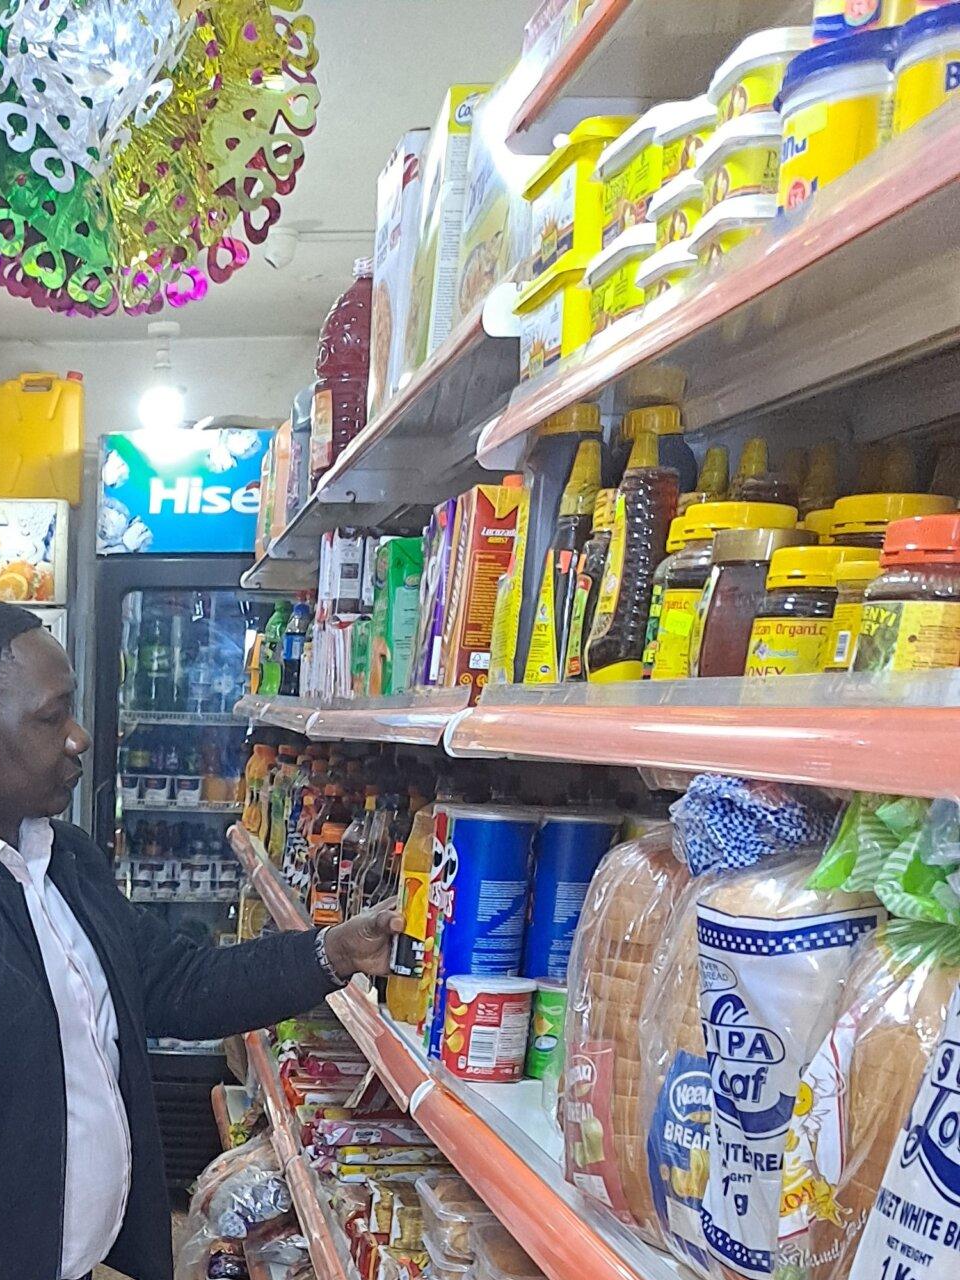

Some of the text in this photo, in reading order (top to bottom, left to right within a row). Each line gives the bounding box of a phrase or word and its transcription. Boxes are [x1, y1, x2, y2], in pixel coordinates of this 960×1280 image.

[148, 477, 261, 515] Hise
[775, 623, 827, 637] Organic
[899, 1200, 943, 1242] WHITE
[899, 1241, 934, 1268] WEIGHT
